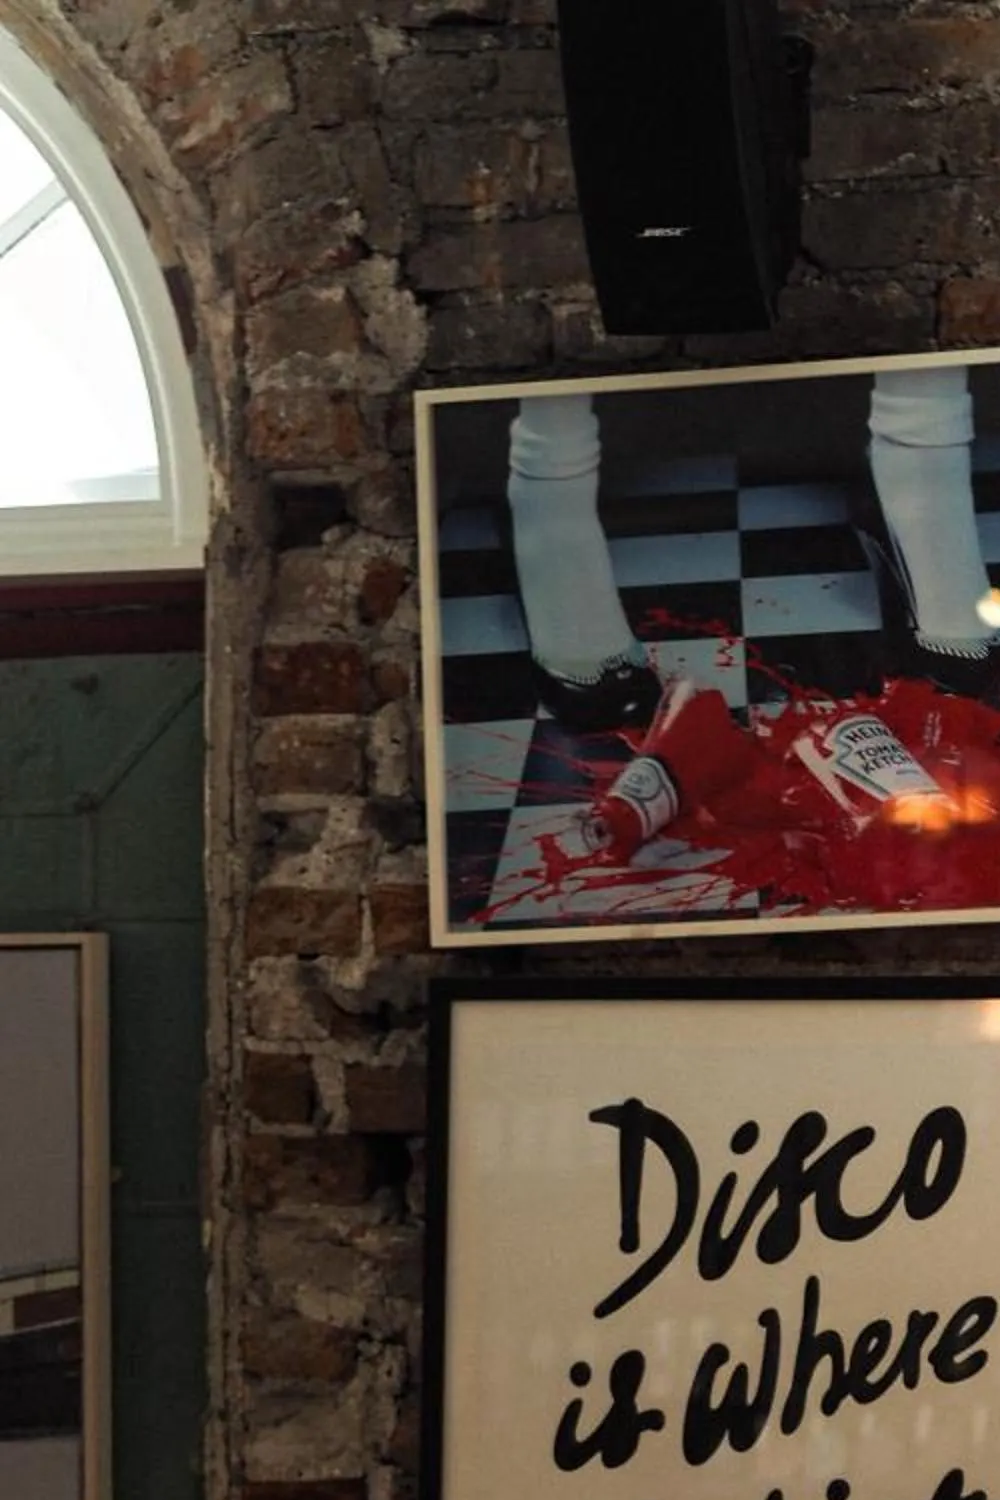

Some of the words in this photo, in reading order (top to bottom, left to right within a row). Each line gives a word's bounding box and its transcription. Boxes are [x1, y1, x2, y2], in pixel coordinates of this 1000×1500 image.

[845, 727, 889, 743] HEIN
[856, 744, 904, 761] TOMA
[862, 754, 913, 775] KETCH
[588, 1096, 968, 1320] Disco
[552, 1348, 666, 1473] is
